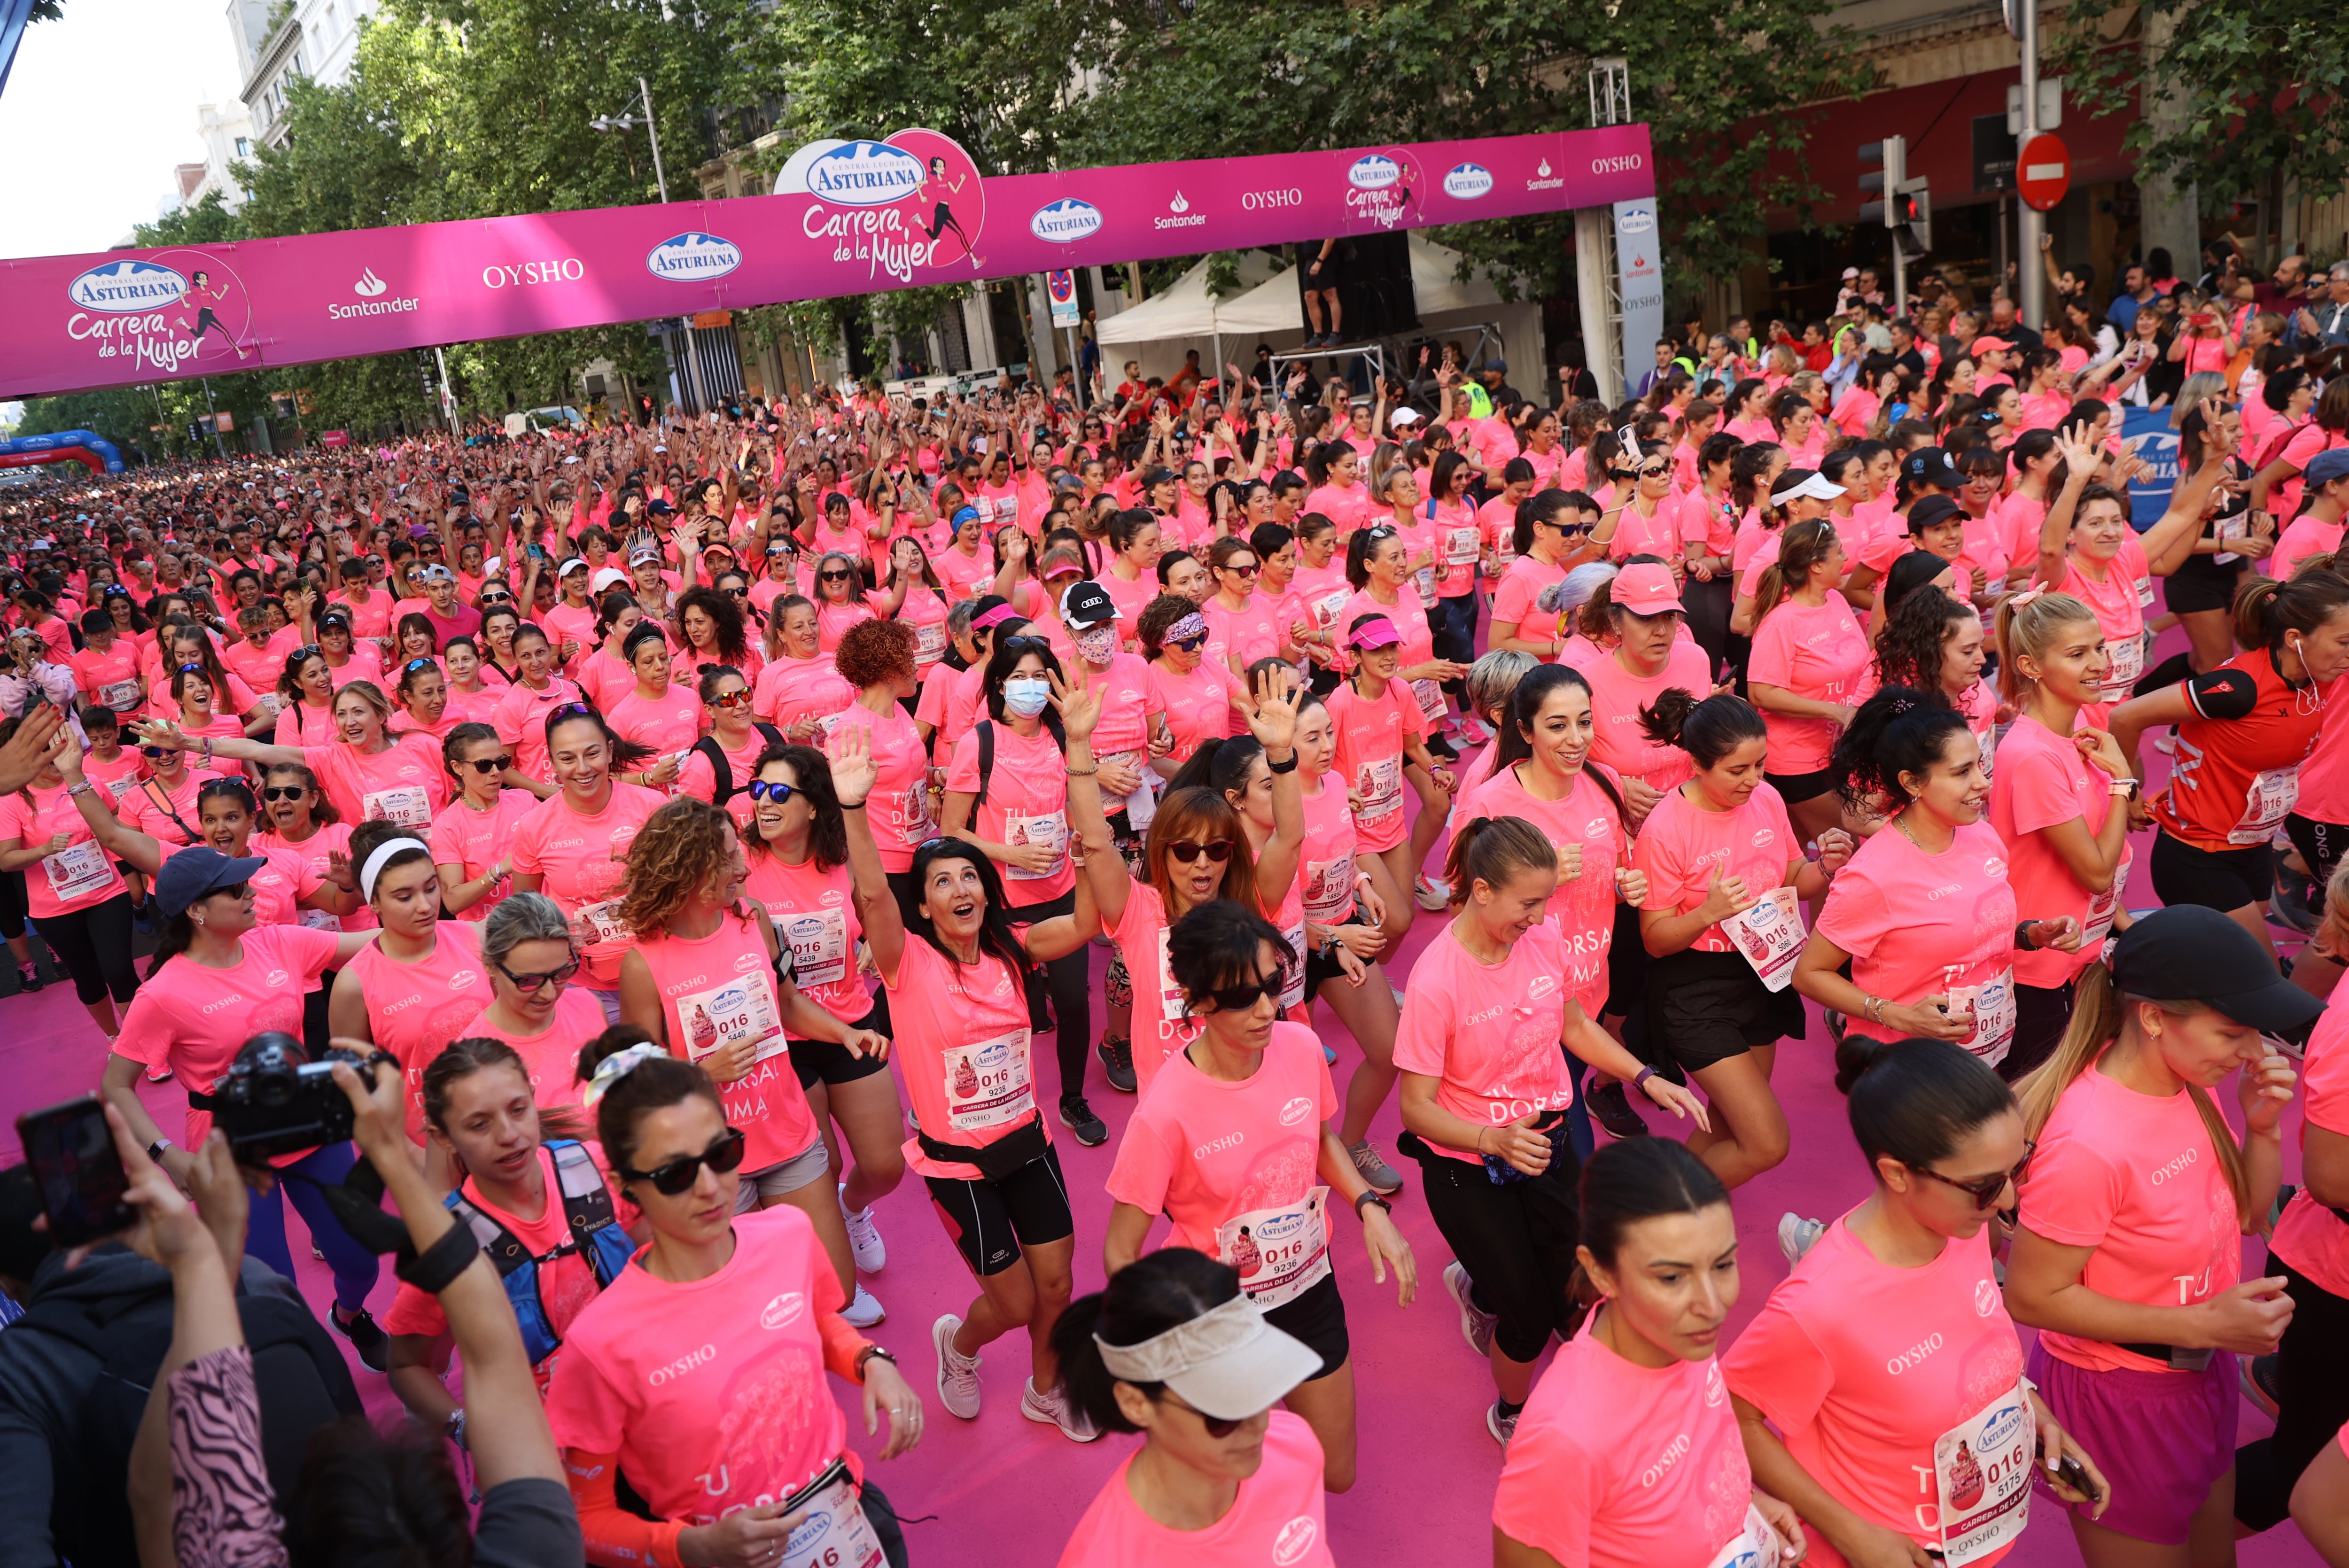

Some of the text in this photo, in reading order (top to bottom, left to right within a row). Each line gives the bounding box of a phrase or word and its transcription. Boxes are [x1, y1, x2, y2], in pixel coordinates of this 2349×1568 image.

[832, 160, 911, 171] CENTRAL LECHERA
[1592, 154, 1642, 175] OYSHO
[817, 167, 916, 191] ASTURIANA
[1353, 169, 1396, 181] ASTURIANA
[1447, 179, 1490, 192] ASTURIANA
[1527, 178, 1564, 191] Santander
[1242, 188, 1302, 211] OYSHO
[1346, 188, 1390, 206] Carrera
[802, 204, 902, 239] Carrera
[1154, 213, 1206, 229] Santander
[1359, 200, 1406, 229] de la Mujer
[1037, 217, 1097, 233] ASTURIANA
[656, 253, 735, 272] ASTURIANA
[833, 227, 941, 282] de la Mujer
[95, 277, 133, 286] CENTRAL
[482, 258, 584, 289] OYSHO
[1625, 267, 1656, 279] Santander
[81, 282, 180, 303] ASTURIANA
[328, 296, 420, 320] Santander
[1625, 294, 1661, 311] OYSHO
[67, 312, 167, 340] Carrera
[99, 328, 206, 373] de la Mujer
[921, 638, 934, 646] 016
[1807, 631, 1831, 645] OYSHO
[2116, 662, 2131, 673] 016
[606, 677, 627, 686] OYSHO
[786, 673, 809, 683] OYSHO
[1826, 680, 1845, 695] TU
[529, 706, 550, 718] OYSHO
[640, 719, 663, 729] OYSHO
[1376, 779, 1391, 791] 016
[2263, 796, 2282, 811] 016
[389, 809, 410, 820] 016
[466, 833, 493, 846] OYSHO
[550, 838, 583, 850] OYSHO
[1754, 833, 1774, 847] ASTURIANA
[63, 851, 85, 863] ASTURIANA
[1697, 846, 1730, 865] OYSHO
[69, 862, 88, 874] 016
[62, 887, 82, 897] OYSHO
[1326, 878, 1344, 893] 016
[1927, 884, 1963, 901] OYSHO
[821, 895, 843, 904] ASTURIANA
[1775, 896, 1790, 905] SUMA
[1754, 908, 1777, 926] ASTURIANA
[792, 926, 822, 934] ASTURIANA
[1766, 924, 1788, 944] 016
[793, 941, 821, 955] 016
[1777, 939, 1792, 952] 5060
[736, 957, 761, 970] ASTURIANA
[1766, 958, 1784, 972] CARRERA
[451, 975, 476, 988] ASTURIANA
[816, 970, 839, 979] Santander
[1771, 968, 1792, 985] OYSHO
[667, 974, 707, 996] OYSHO
[748, 981, 763, 992] SUMA
[202, 994, 241, 1015] OYSHO
[383, 994, 421, 1016] OYSHO
[712, 995, 744, 1013] ASTURIANA
[1979, 992, 2005, 1007] ASTURIANA
[719, 1013, 749, 1034] 016
[1465, 1005, 1503, 1026] OYSHO
[1980, 1012, 2001, 1032] 016
[728, 1029, 746, 1042] 5440
[1010, 1038, 1025, 1048] SUMA
[1984, 1029, 1998, 1042] 5332
[978, 1050, 1007, 1065] ASTURIANA
[981, 1069, 1009, 1087] 016
[988, 1085, 1006, 1097] 9238
[962, 1102, 989, 1112] CARRERA
[1004, 1092, 1018, 1102] MUJER
[1010, 1097, 1029, 1112] Santander
[961, 1114, 990, 1125] OYSHO
[1282, 1104, 1311, 1125] ASTURIANA
[1194, 1131, 1244, 1160] OYSHO
[2151, 1148, 2198, 1186] OYSHO
[583, 1216, 611, 1233] EVADICT
[1260, 1219, 1303, 1236] ASTURIANA
[1265, 1240, 1302, 1264] 016
[1245, 1281, 1273, 1292] ARRERA
[1293, 1263, 1309, 1277] MUJER
[1310, 1252, 1320, 1264] 2023
[1274, 1259, 1297, 1274] 9236
[1298, 1263, 1323, 1287] Santander
[2172, 1265, 2210, 1305] TU
[763, 1296, 804, 1326] ASTURIANA
[1887, 1332, 1943, 1375] OYSHO
[649, 1344, 716, 1387] OYSHO
[1981, 1414, 2021, 1449] ASTURIANA
[1642, 1433, 1691, 1488] OYSHO
[1988, 1444, 2023, 1484] 016
[1998, 1471, 2021, 1497] 5175
[1960, 1497, 2018, 1531] CARRERA DE LA
[1959, 1525, 1999, 1552] OYSHO
[809, 1547, 840, 1568] 16
